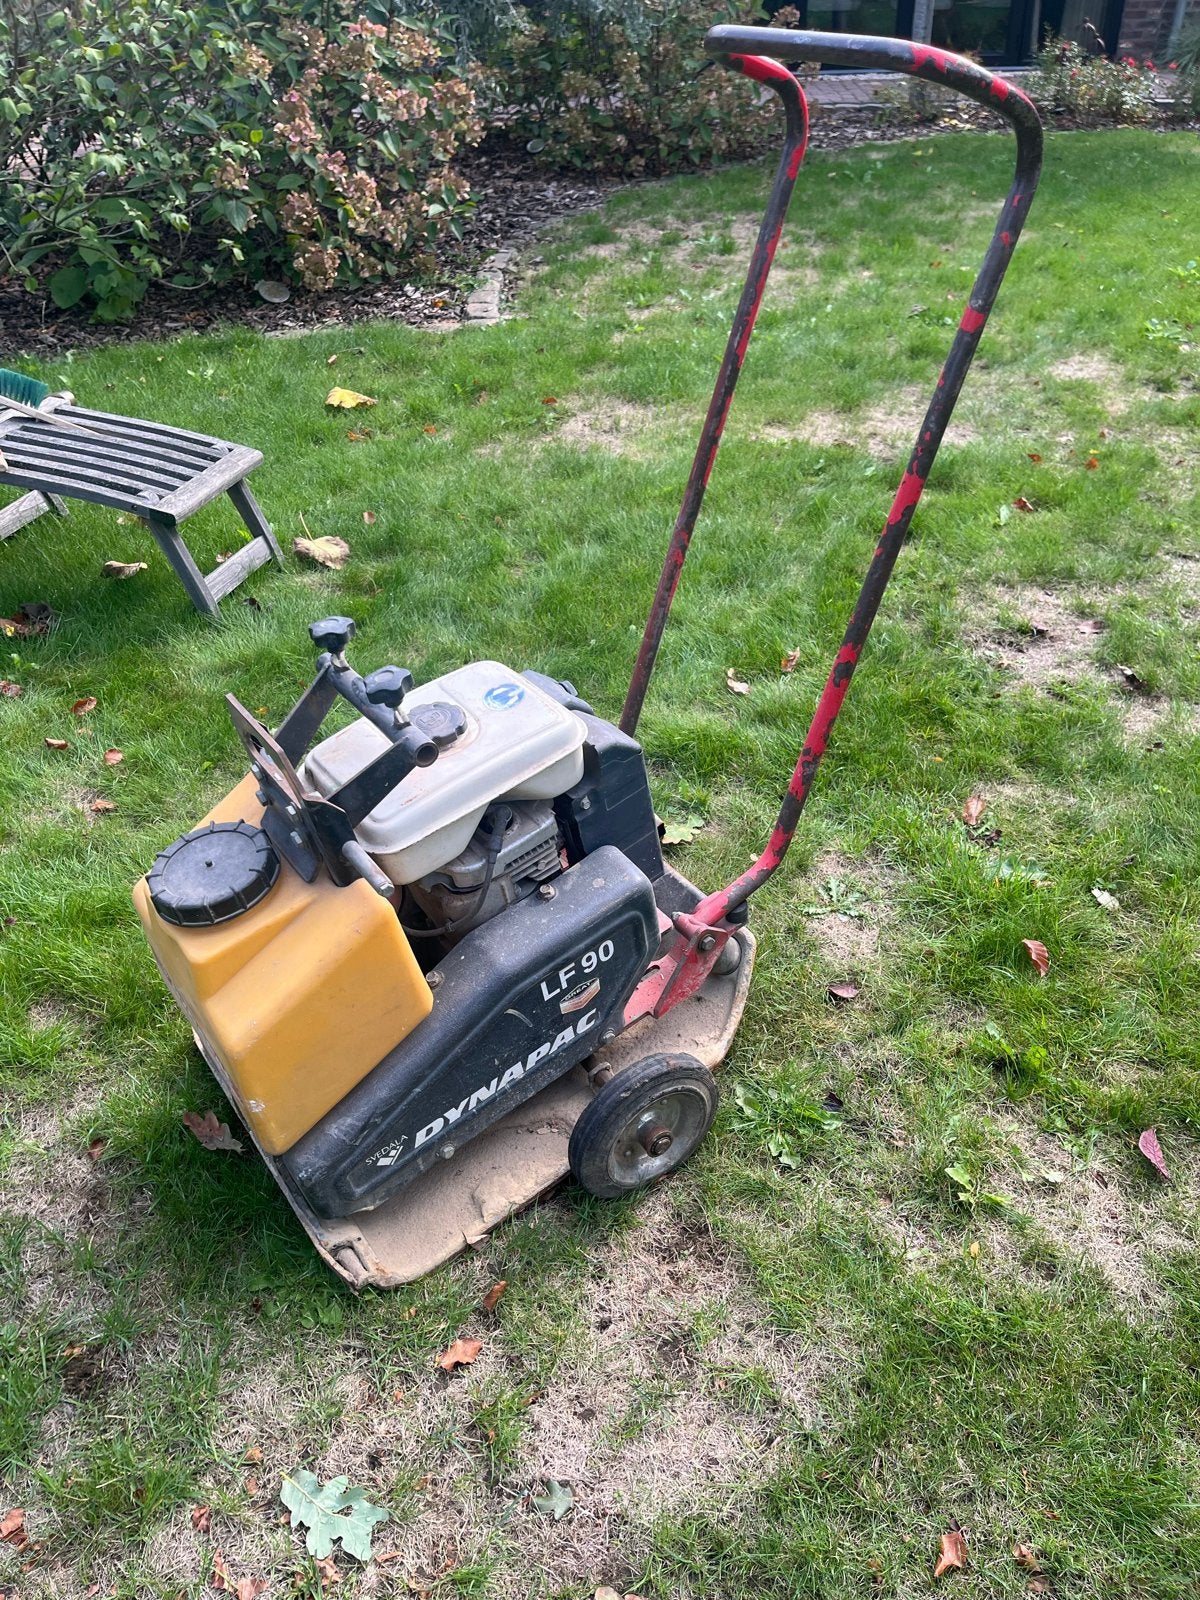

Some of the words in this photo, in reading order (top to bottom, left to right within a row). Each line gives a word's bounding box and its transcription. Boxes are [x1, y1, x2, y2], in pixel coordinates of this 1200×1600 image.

[541, 962, 576, 1002] LF
[581, 940, 614, 973] 90
[414, 1008, 597, 1149] DYNAPAC
[365, 1134, 409, 1166] SVEDALA
